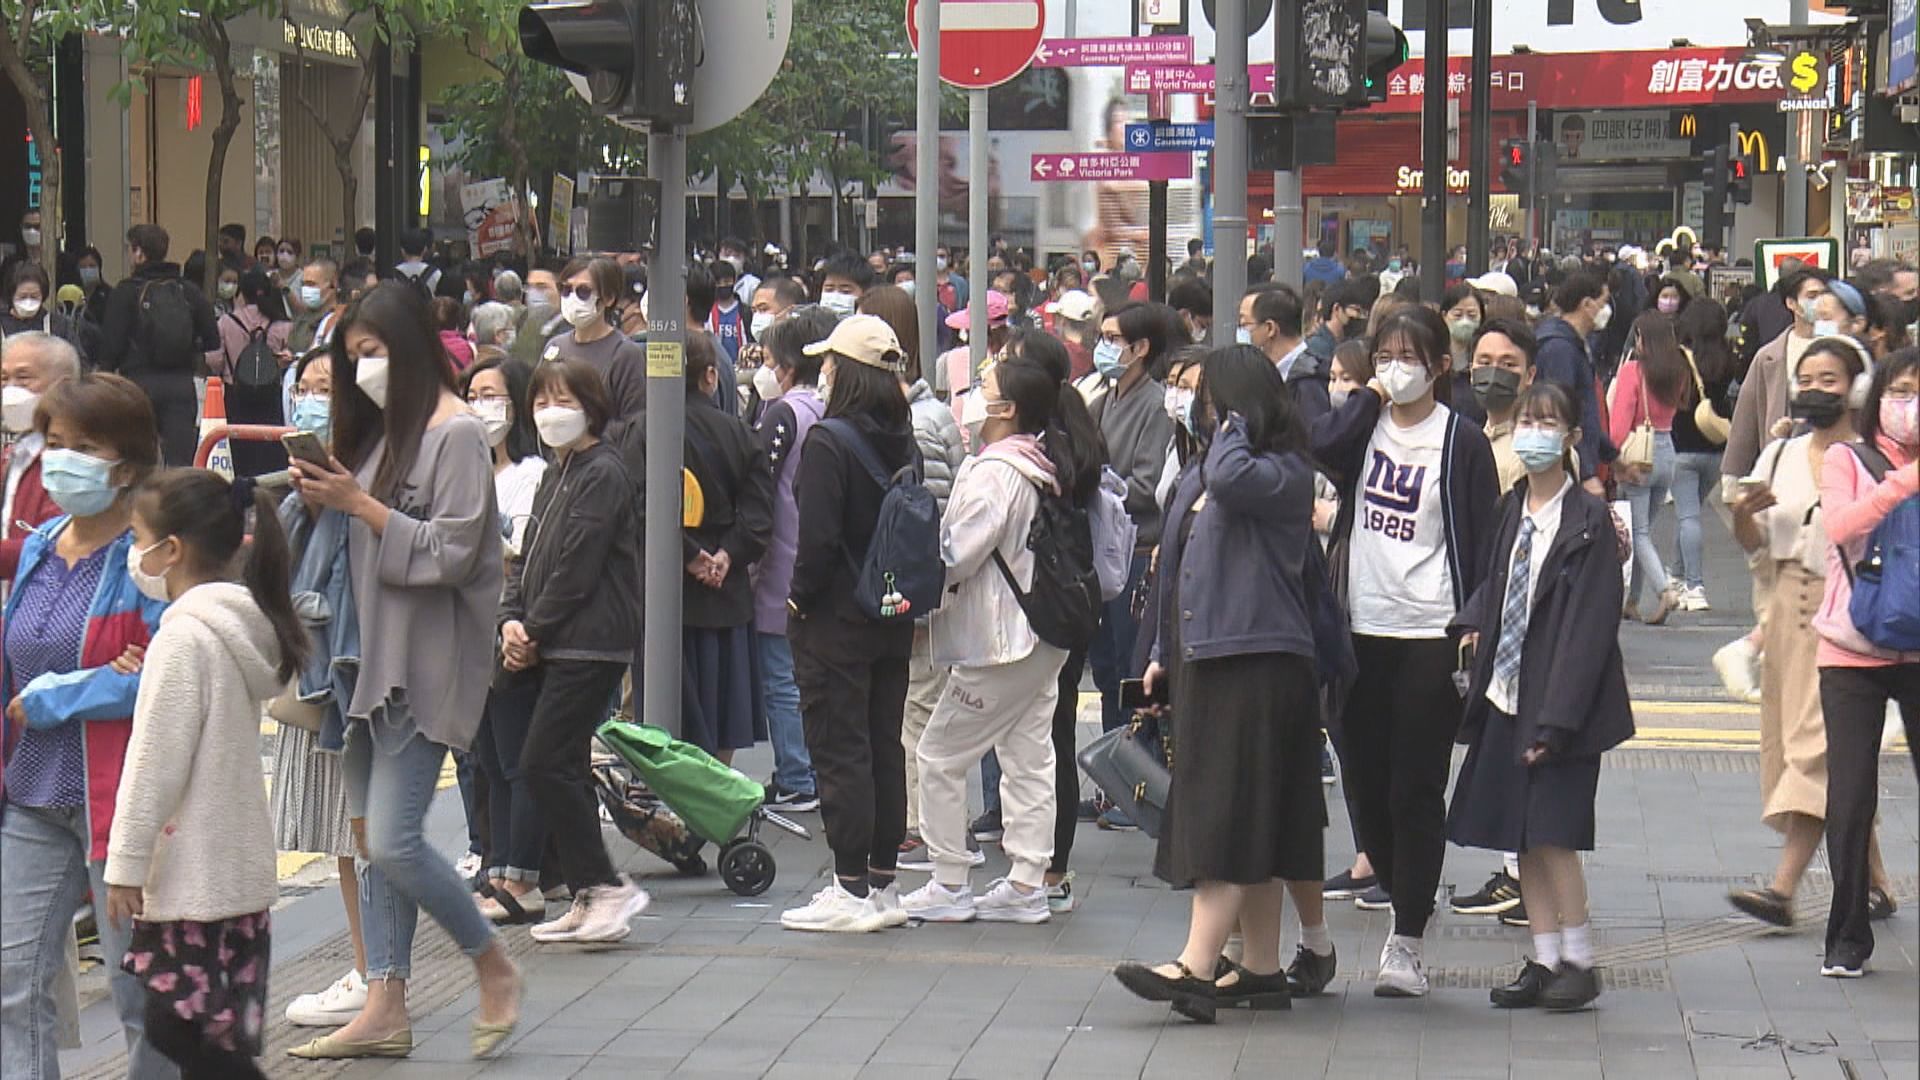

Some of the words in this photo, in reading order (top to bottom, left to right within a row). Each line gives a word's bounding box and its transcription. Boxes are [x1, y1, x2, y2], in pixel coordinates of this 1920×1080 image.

[1155, 80, 1180, 89] World
[1182, 80, 1207, 89] Trade
[1779, 100, 1827, 112] CHANGE
[1592, 118, 1670, 141] 四眼仔開
[1154, 138, 1197, 147] Causeway
[1199, 136, 1216, 147] Bay
[1079, 168, 1112, 177] Victoria
[1113, 168, 1134, 177] Park
[951, 686, 984, 709] FILA
